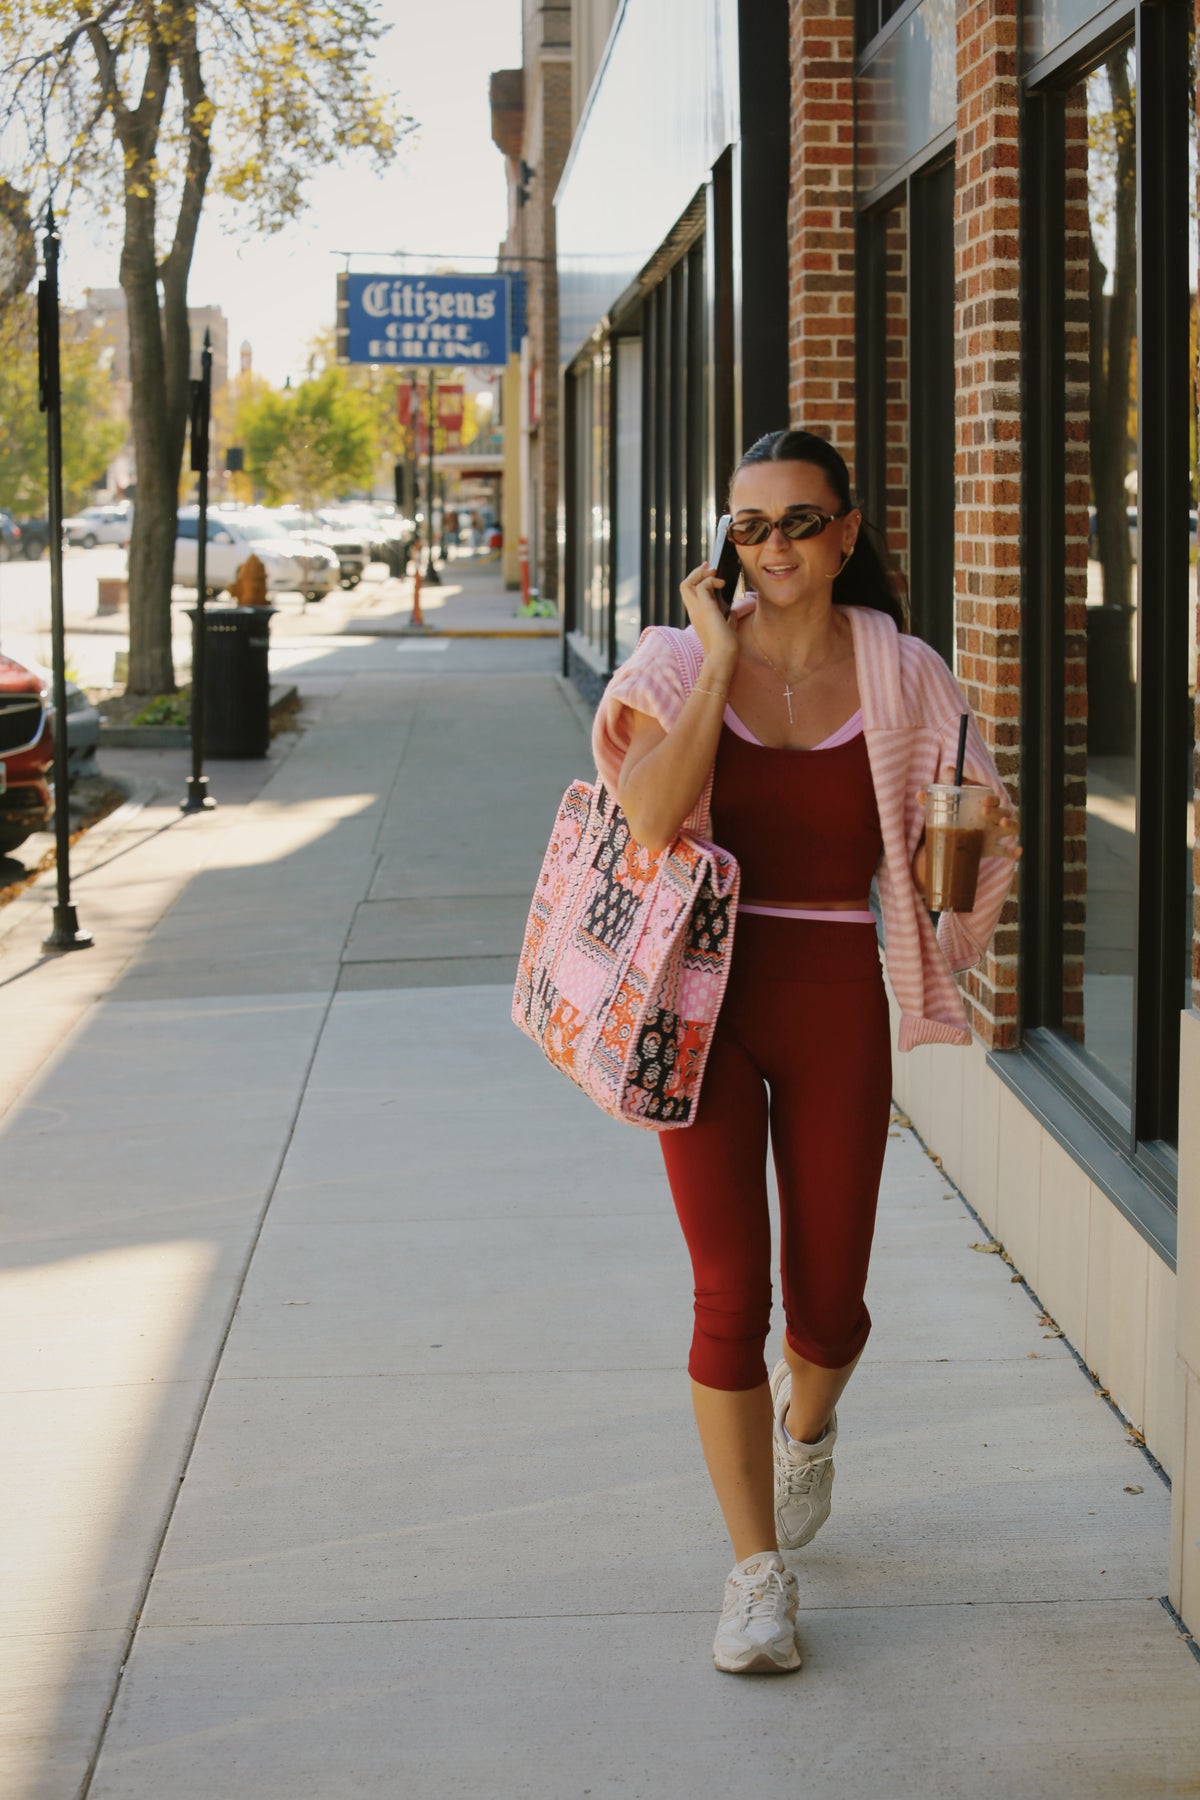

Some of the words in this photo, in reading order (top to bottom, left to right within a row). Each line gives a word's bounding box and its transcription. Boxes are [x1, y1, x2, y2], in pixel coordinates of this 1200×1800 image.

[361, 281, 497, 322] Citizens
[385, 322, 473, 340] OFFICE
[368, 340, 489, 359] BUILDING
